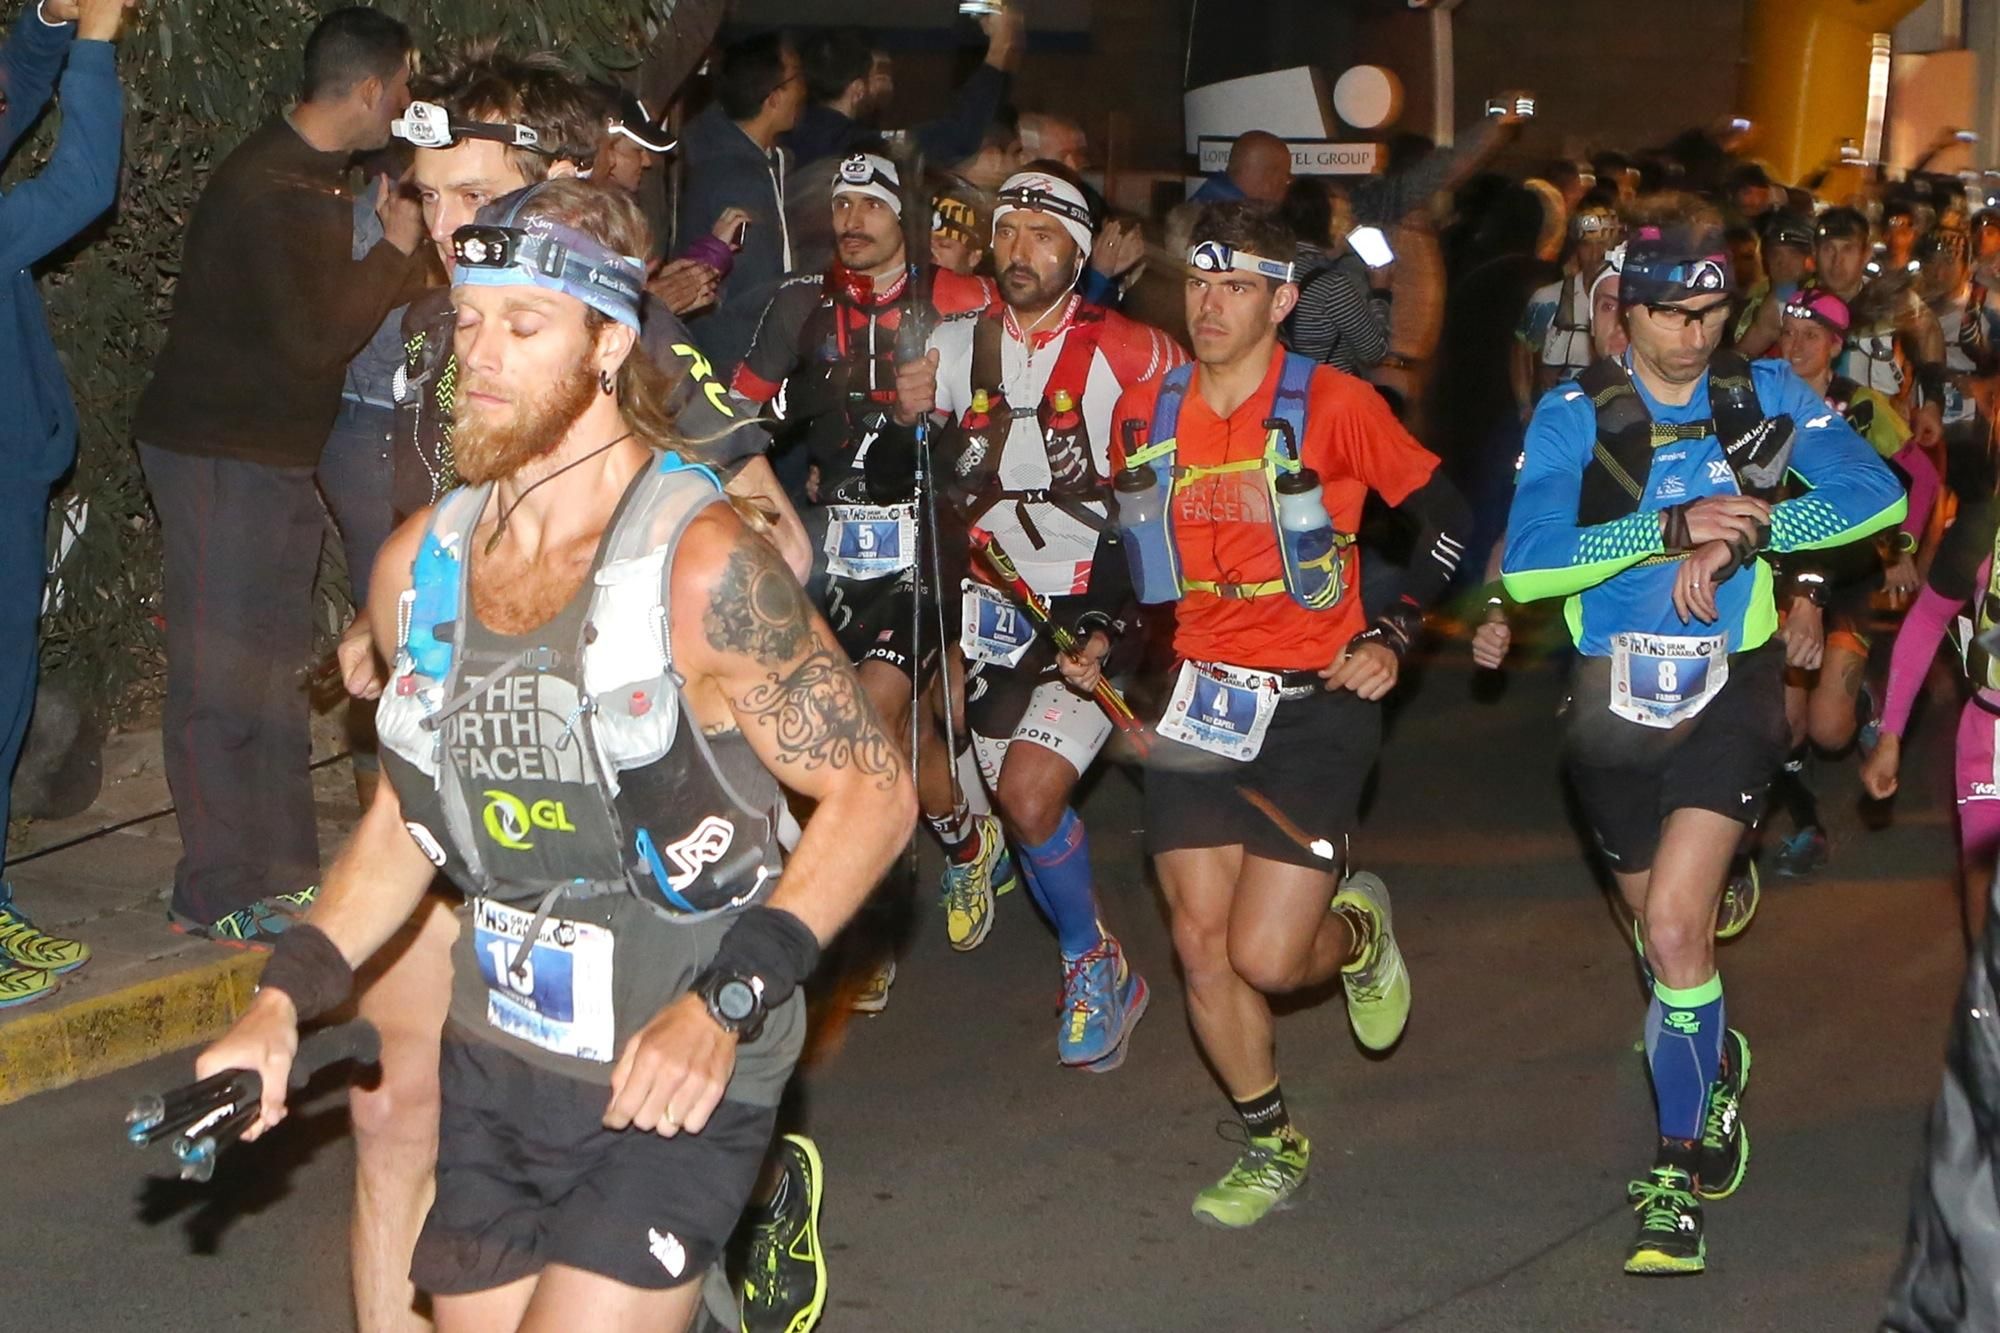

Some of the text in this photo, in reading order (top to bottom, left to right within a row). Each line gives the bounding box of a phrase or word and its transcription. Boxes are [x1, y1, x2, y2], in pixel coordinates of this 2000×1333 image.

[1204, 151, 1231, 162] LOPE
[1317, 151, 1371, 165] GROUP
[1182, 502, 1240, 522] FACE
[857, 524, 875, 550] 5
[1630, 639, 1666, 657] TRANS
[1657, 660, 1678, 693] 8
[464, 674, 537, 711] THE
[1212, 686, 1229, 717] 4
[448, 711, 538, 747] RTH
[451, 746, 544, 782] FACE
